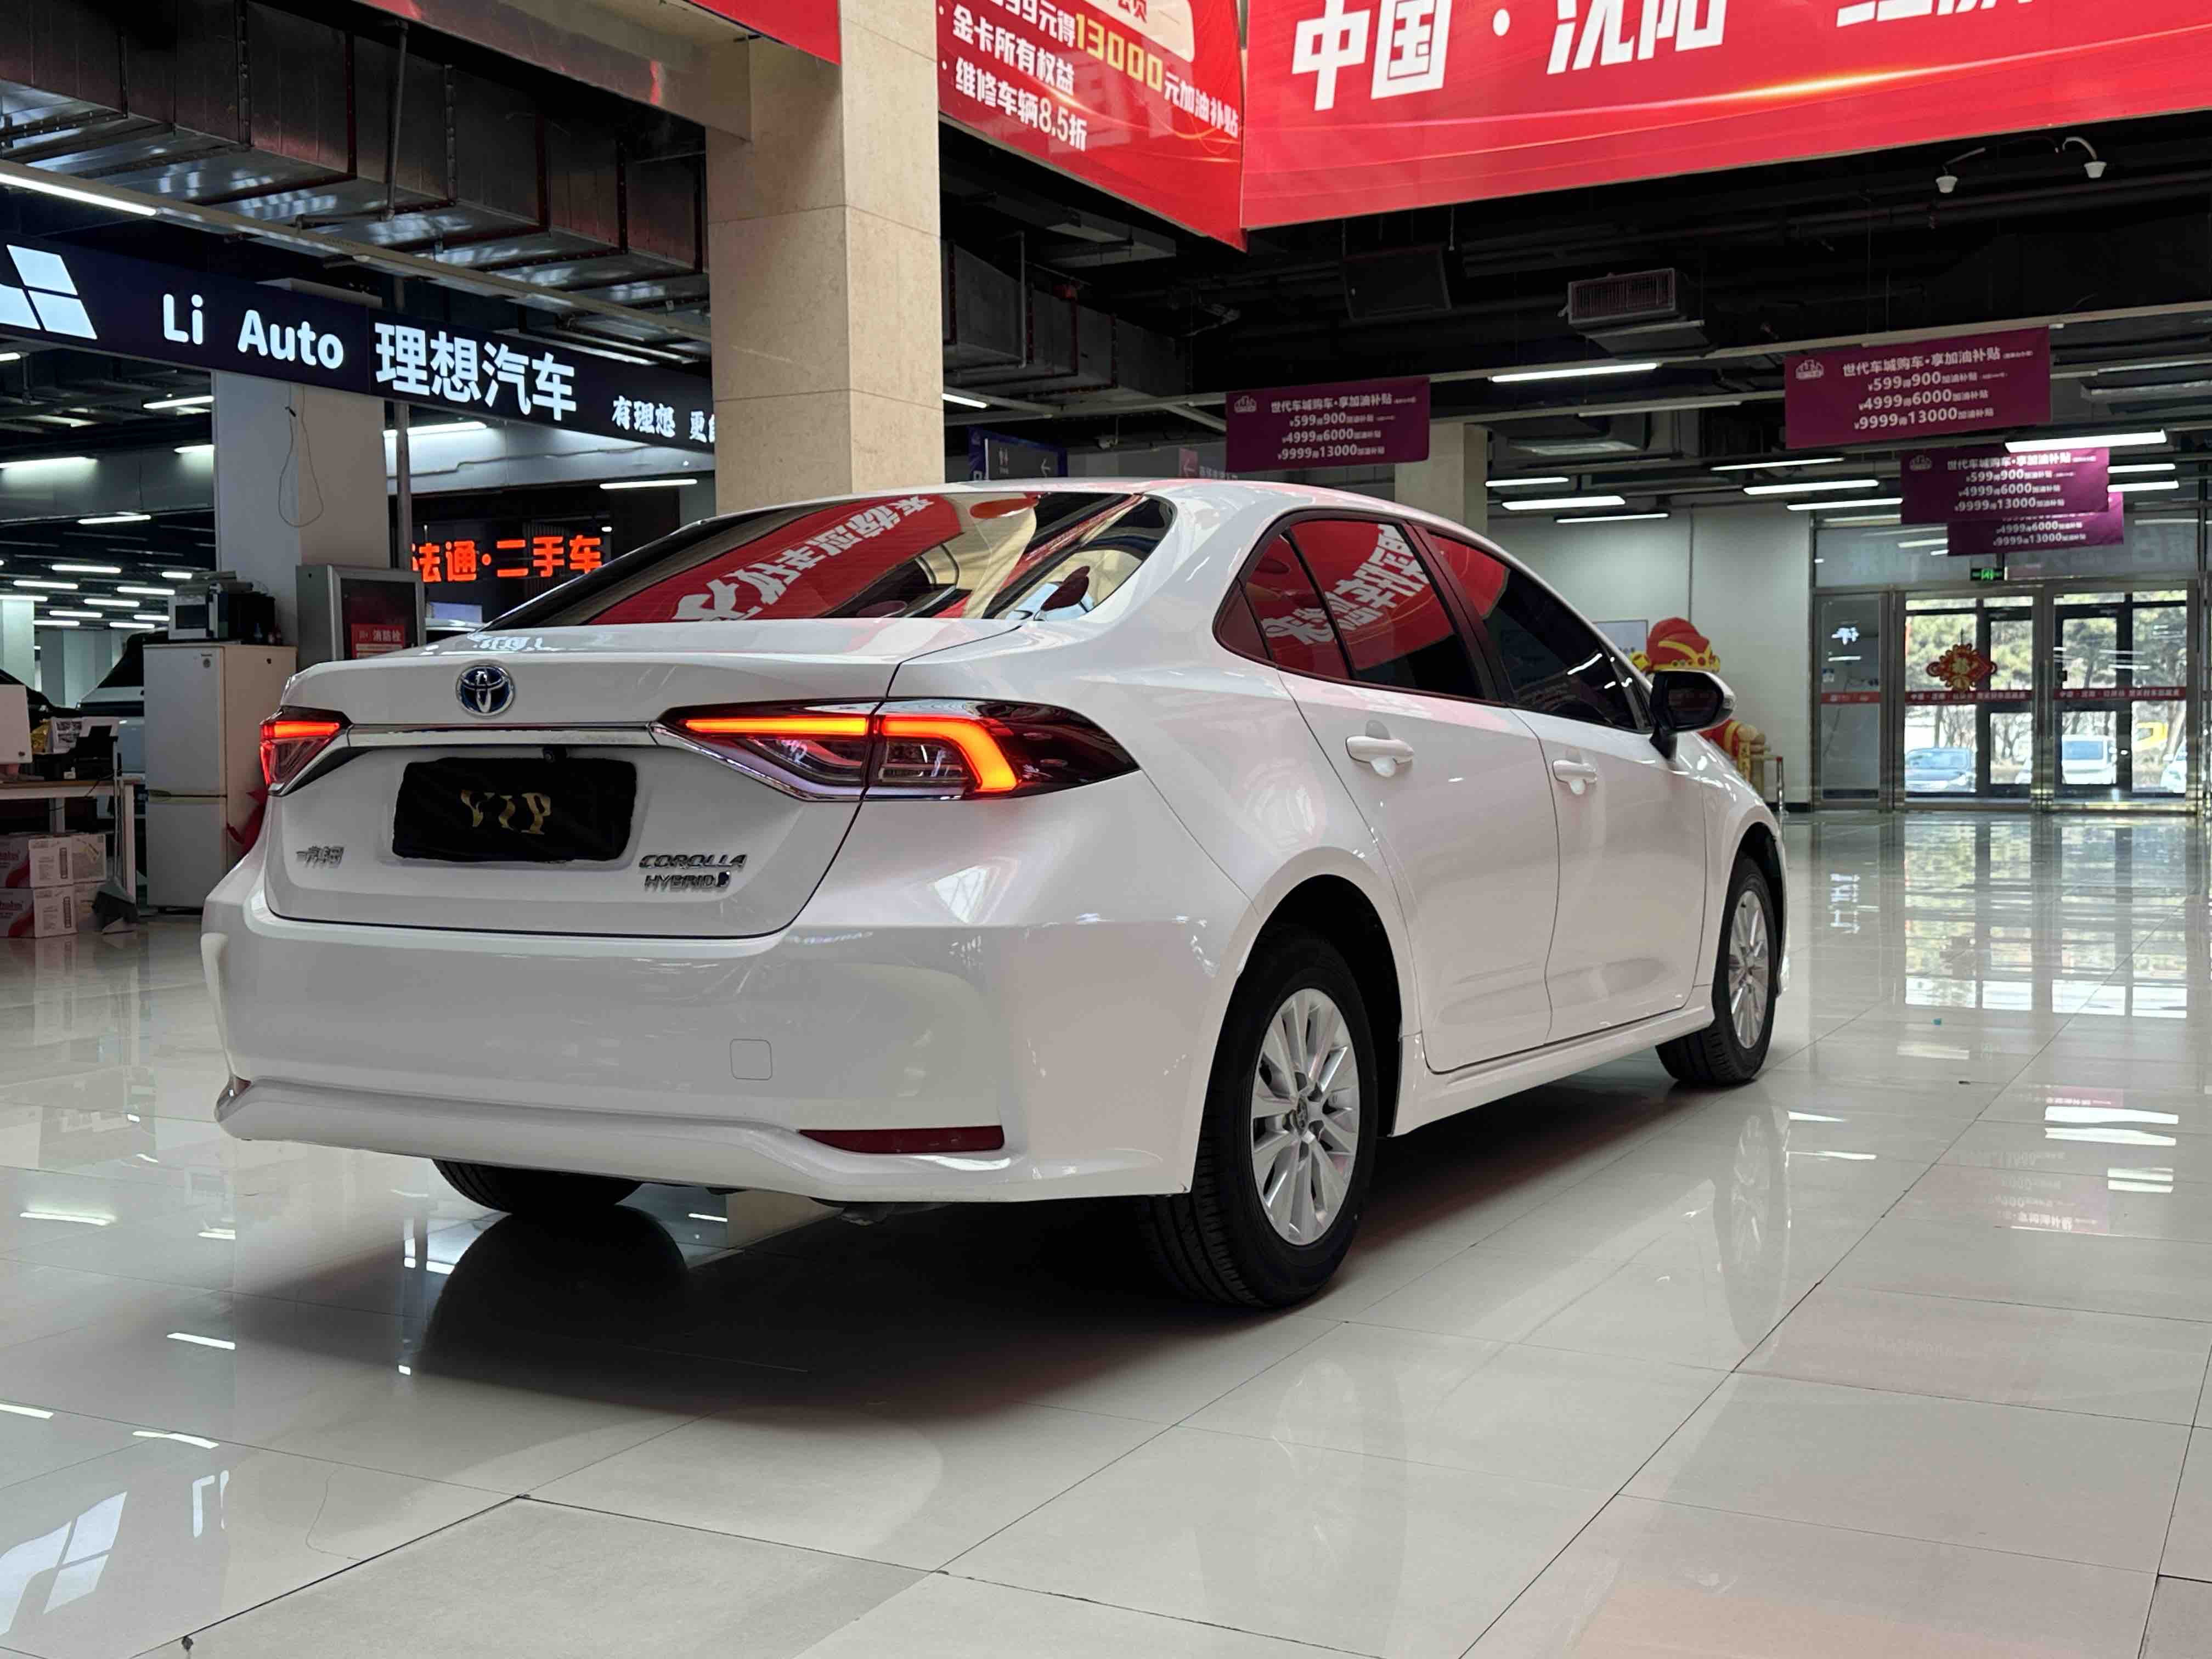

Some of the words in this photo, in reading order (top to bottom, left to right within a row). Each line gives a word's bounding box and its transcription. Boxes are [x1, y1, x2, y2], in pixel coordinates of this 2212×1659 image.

[953, 4, 1074, 95] 金卡所有权益
[956, 57, 1087, 151] 维修车辆8.5折
[163, 294, 204, 345] Li
[238, 309, 344, 369] Auto
[375, 322, 577, 421] 理想汽车
[612, 395, 675, 438] 有理想
[690, 411, 715, 443] 更
[461, 789, 551, 835] VIP
[639, 854, 747, 869] COROLLA
[644, 874, 714, 888] HYBRID
